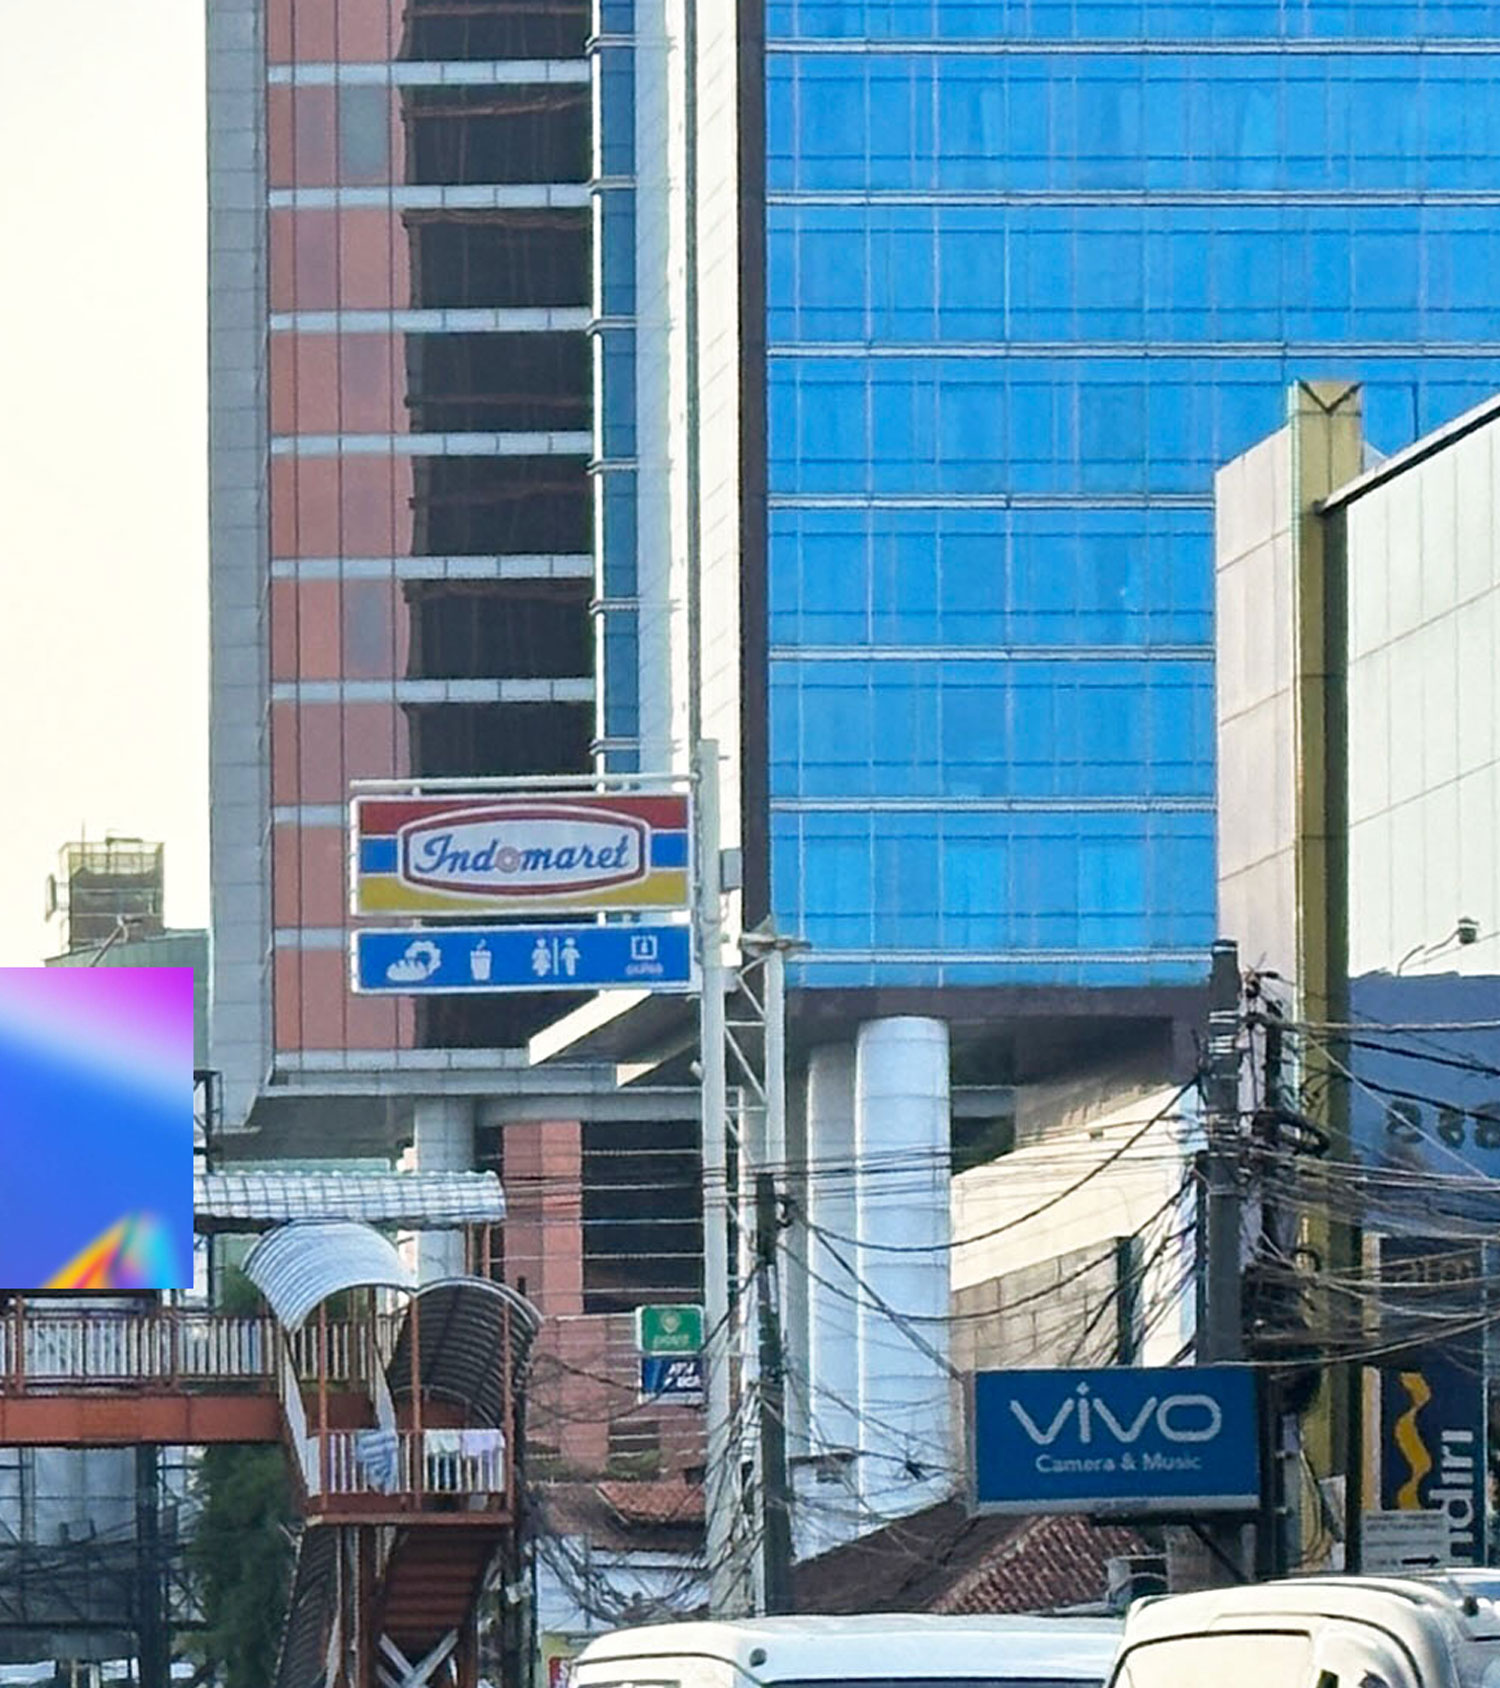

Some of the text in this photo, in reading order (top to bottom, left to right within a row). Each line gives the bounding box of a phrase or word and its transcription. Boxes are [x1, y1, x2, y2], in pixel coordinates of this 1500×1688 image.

[413, 834, 630, 874] Indomaret
[1010, 1382, 1222, 1445] vivo
[1036, 1452, 1201, 1472] Camera & Music
[1428, 1430, 1474, 1566] ndiri
